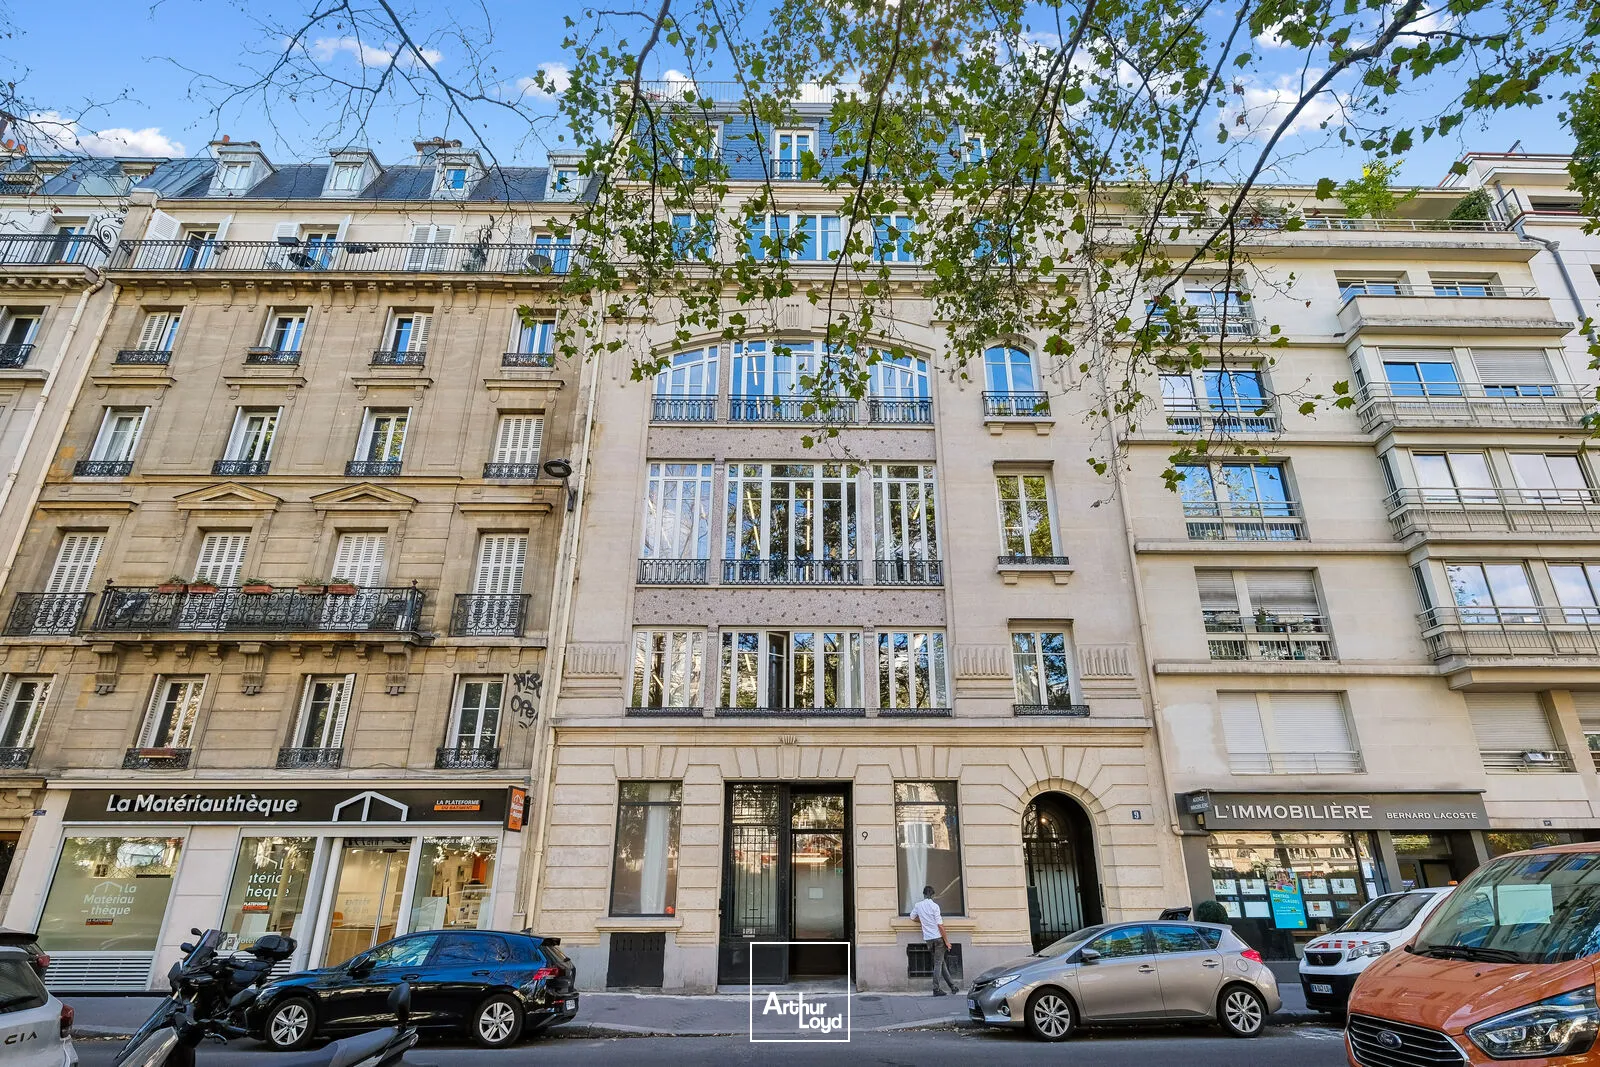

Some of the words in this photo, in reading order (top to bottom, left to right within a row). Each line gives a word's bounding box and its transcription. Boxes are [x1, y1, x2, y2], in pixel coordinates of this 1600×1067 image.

[106, 794, 131, 812] La
[134, 794, 299, 817] Matériauthèque
[1214, 802, 1373, 820] L'IMMOBILIÈRE
[1386, 812, 1431, 820] BERNARD
[1433, 812, 1478, 820] LACOSTE
[862, 831, 868, 841] 9
[124, 883, 137, 894] La
[83, 894, 135, 904] Matériau
